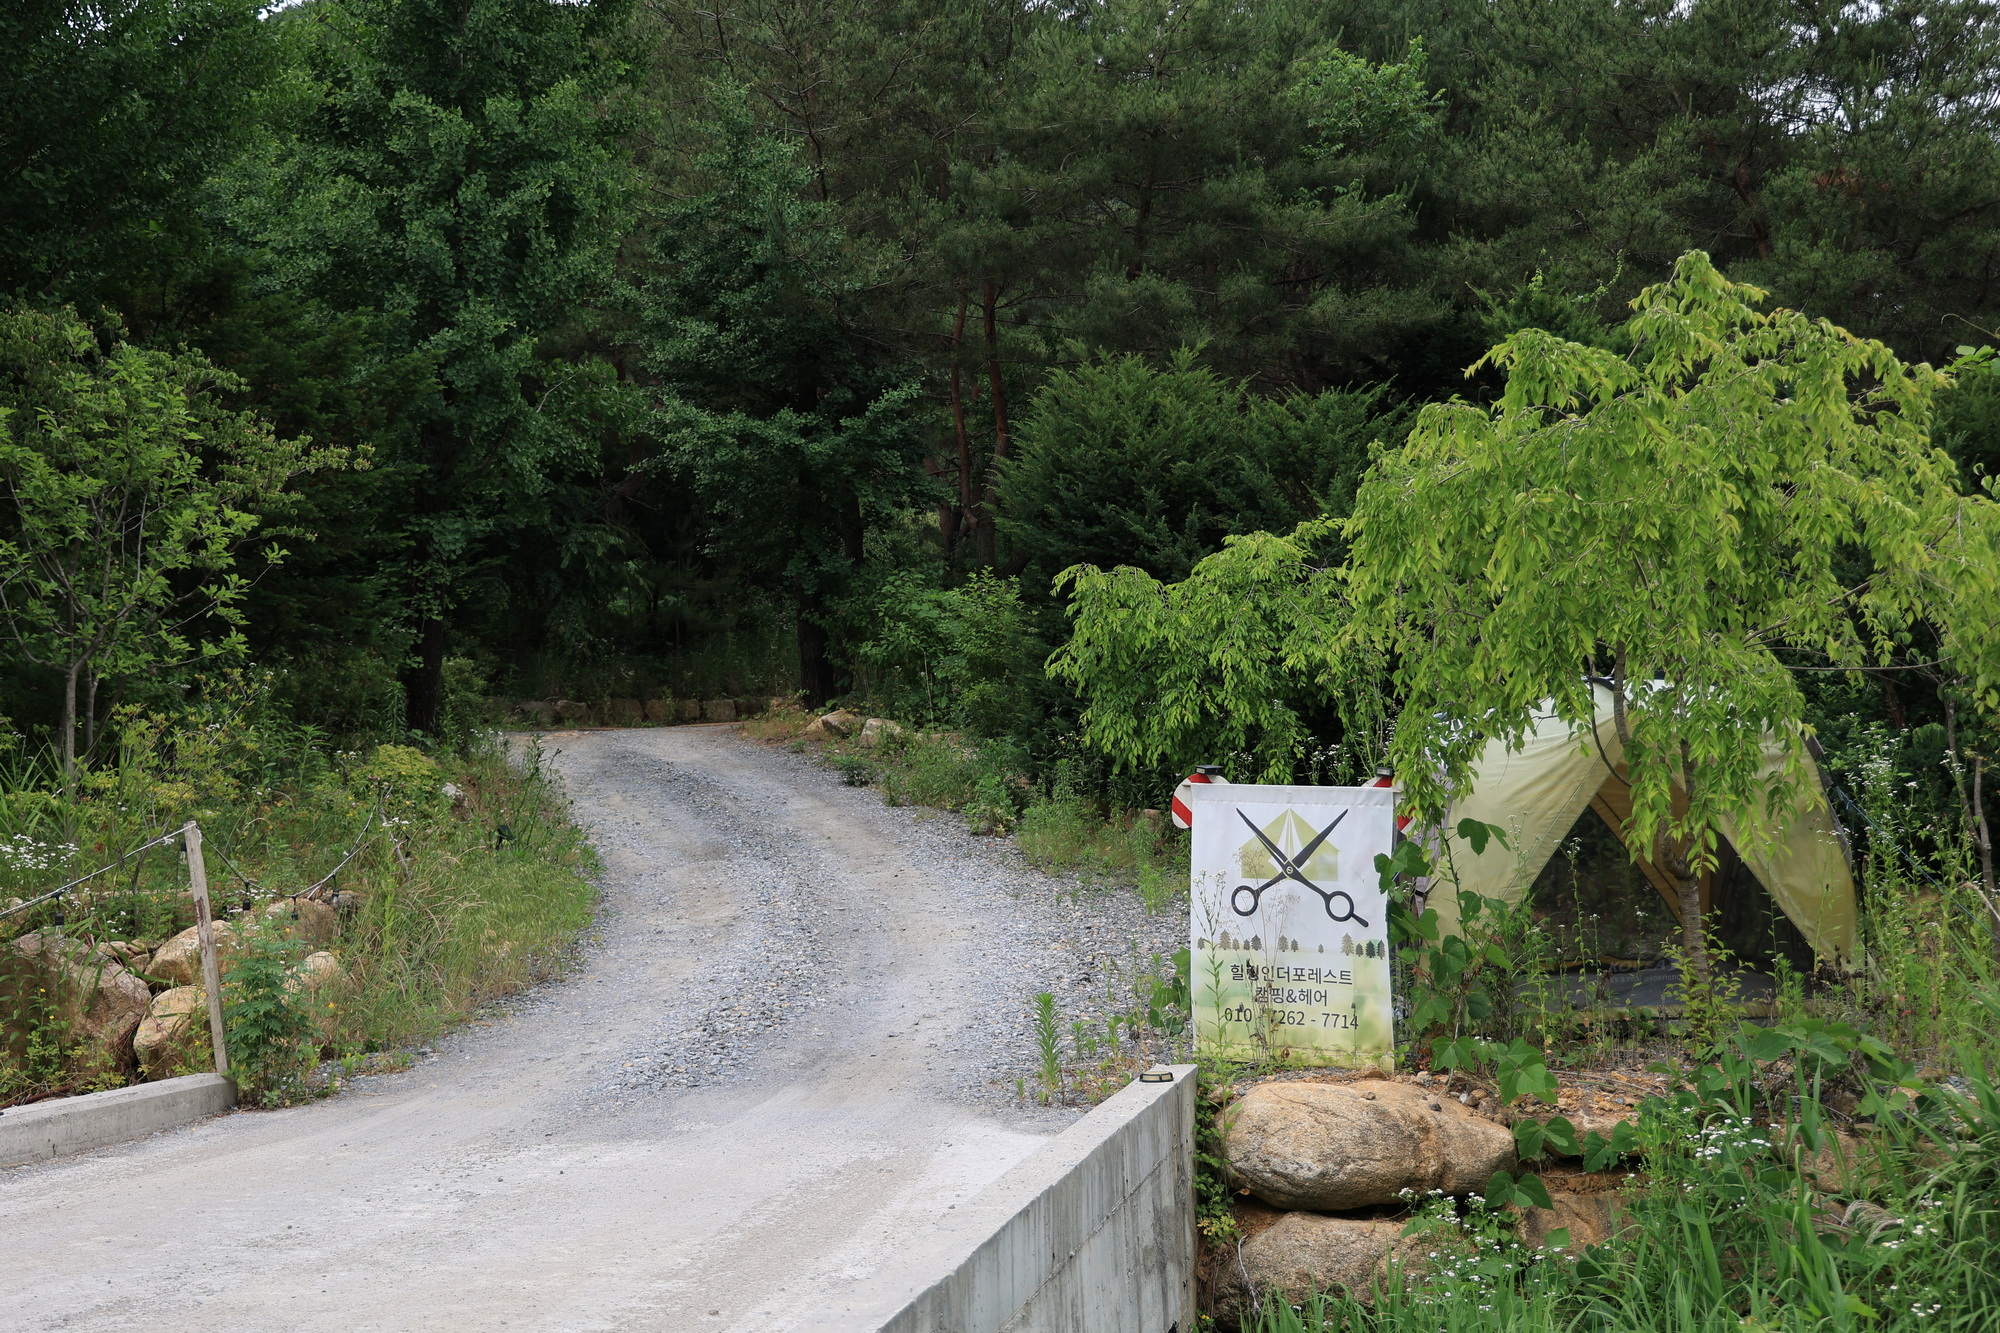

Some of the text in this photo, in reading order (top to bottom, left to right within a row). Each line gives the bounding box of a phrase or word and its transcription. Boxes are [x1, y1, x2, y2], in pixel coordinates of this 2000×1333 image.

[1644, 974, 1683, 982] experienc
[1255, 987, 1327, 1006] 캠핑&헤어
[1224, 1007, 1253, 1023] 010
[1321, 1012, 1359, 1030] 7714
